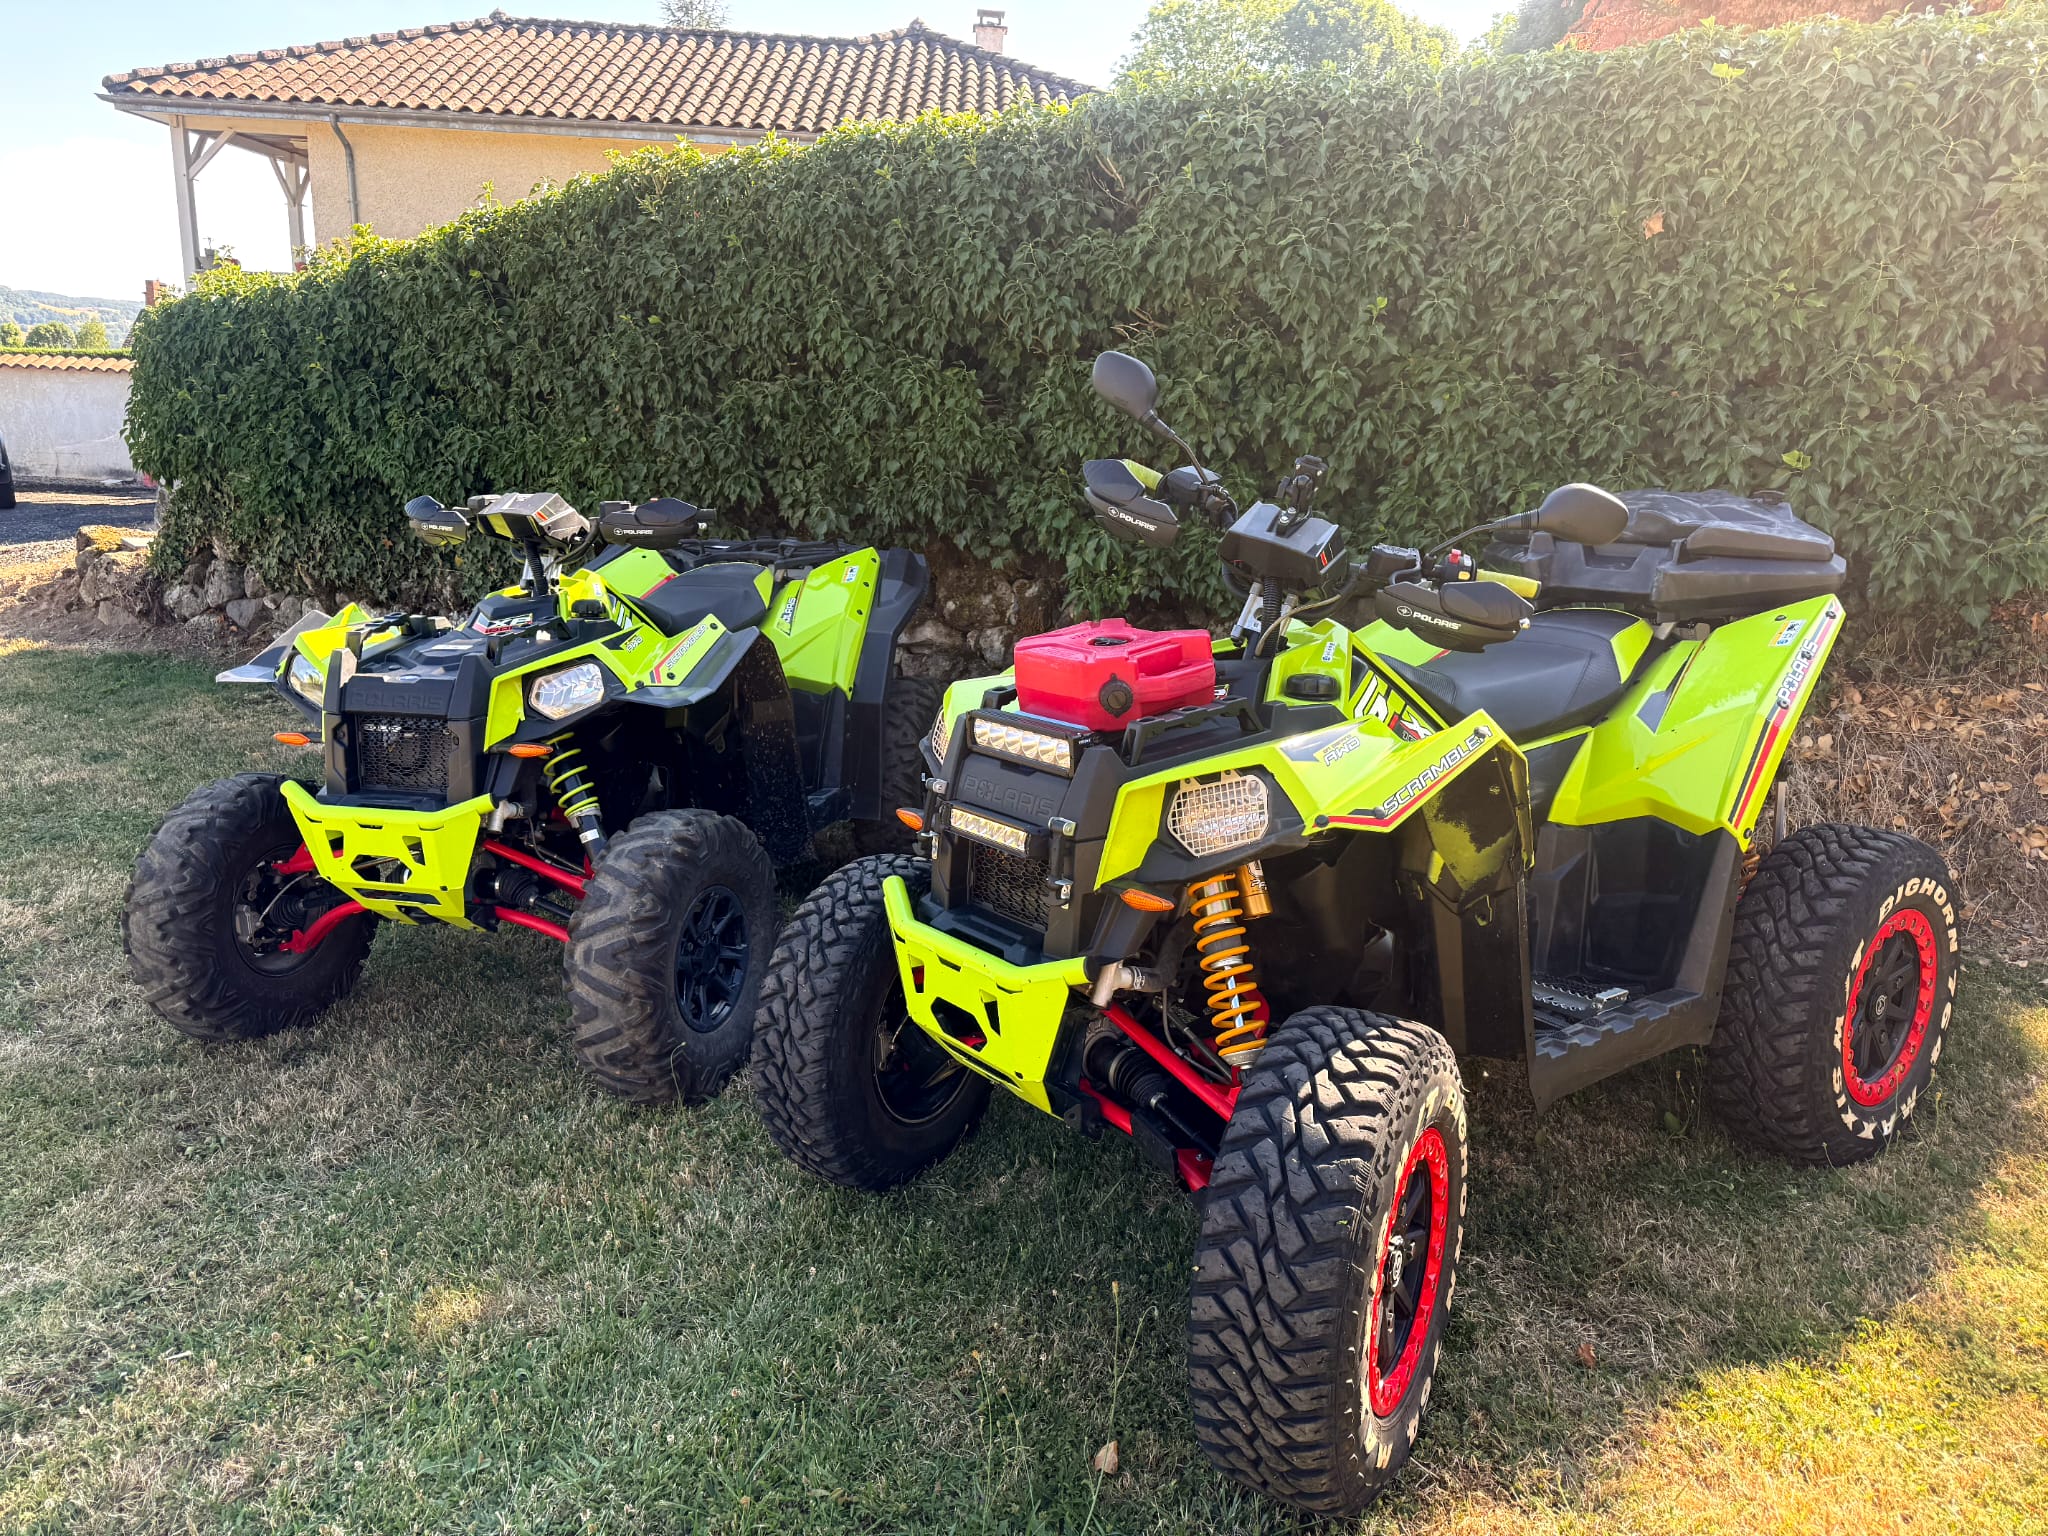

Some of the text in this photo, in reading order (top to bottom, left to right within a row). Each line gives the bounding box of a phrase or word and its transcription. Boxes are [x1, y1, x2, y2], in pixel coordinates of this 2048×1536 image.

[1118, 512, 1158, 532] POLARIS
[1413, 611, 1461, 630] POLARIS
[1776, 638, 1819, 705] POLARIS
[1323, 736, 1360, 767] AWD
[963, 774, 1056, 818] POLARIS
[1879, 877, 1958, 952] BIGHORN
[1832, 1066, 1918, 1140] MAXXIS
